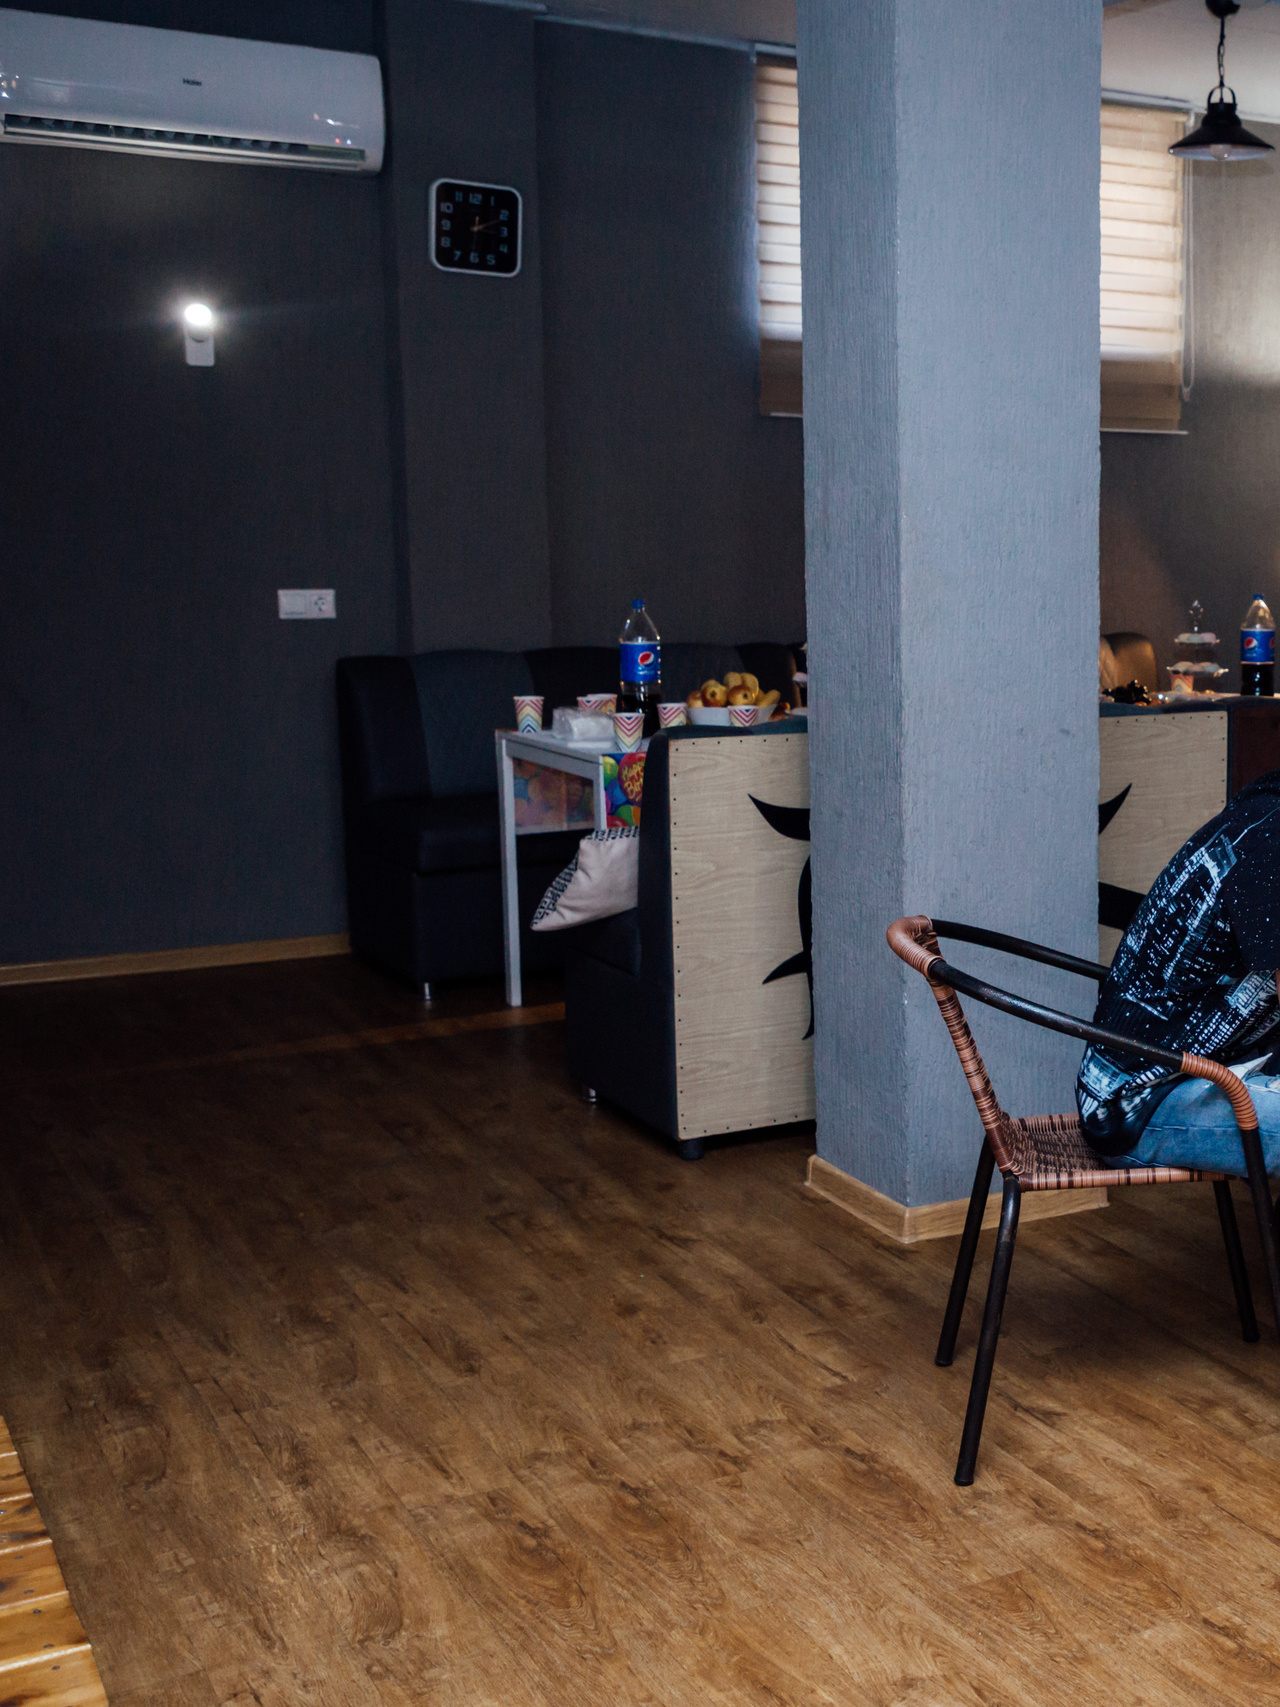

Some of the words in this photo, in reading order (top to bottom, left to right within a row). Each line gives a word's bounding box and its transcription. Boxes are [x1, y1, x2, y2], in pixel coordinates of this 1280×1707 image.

[454, 191, 463, 202] 11
[469, 192, 482, 205] 12
[440, 202, 454, 214] 10
[499, 209, 509, 221] 2
[441, 219, 451, 231] 9
[500, 226, 508, 238] 3
[440, 236, 451, 248] 8
[453, 250, 462, 261] 7
[469, 251, 480, 263] 6
[486, 253, 496, 265] 5
